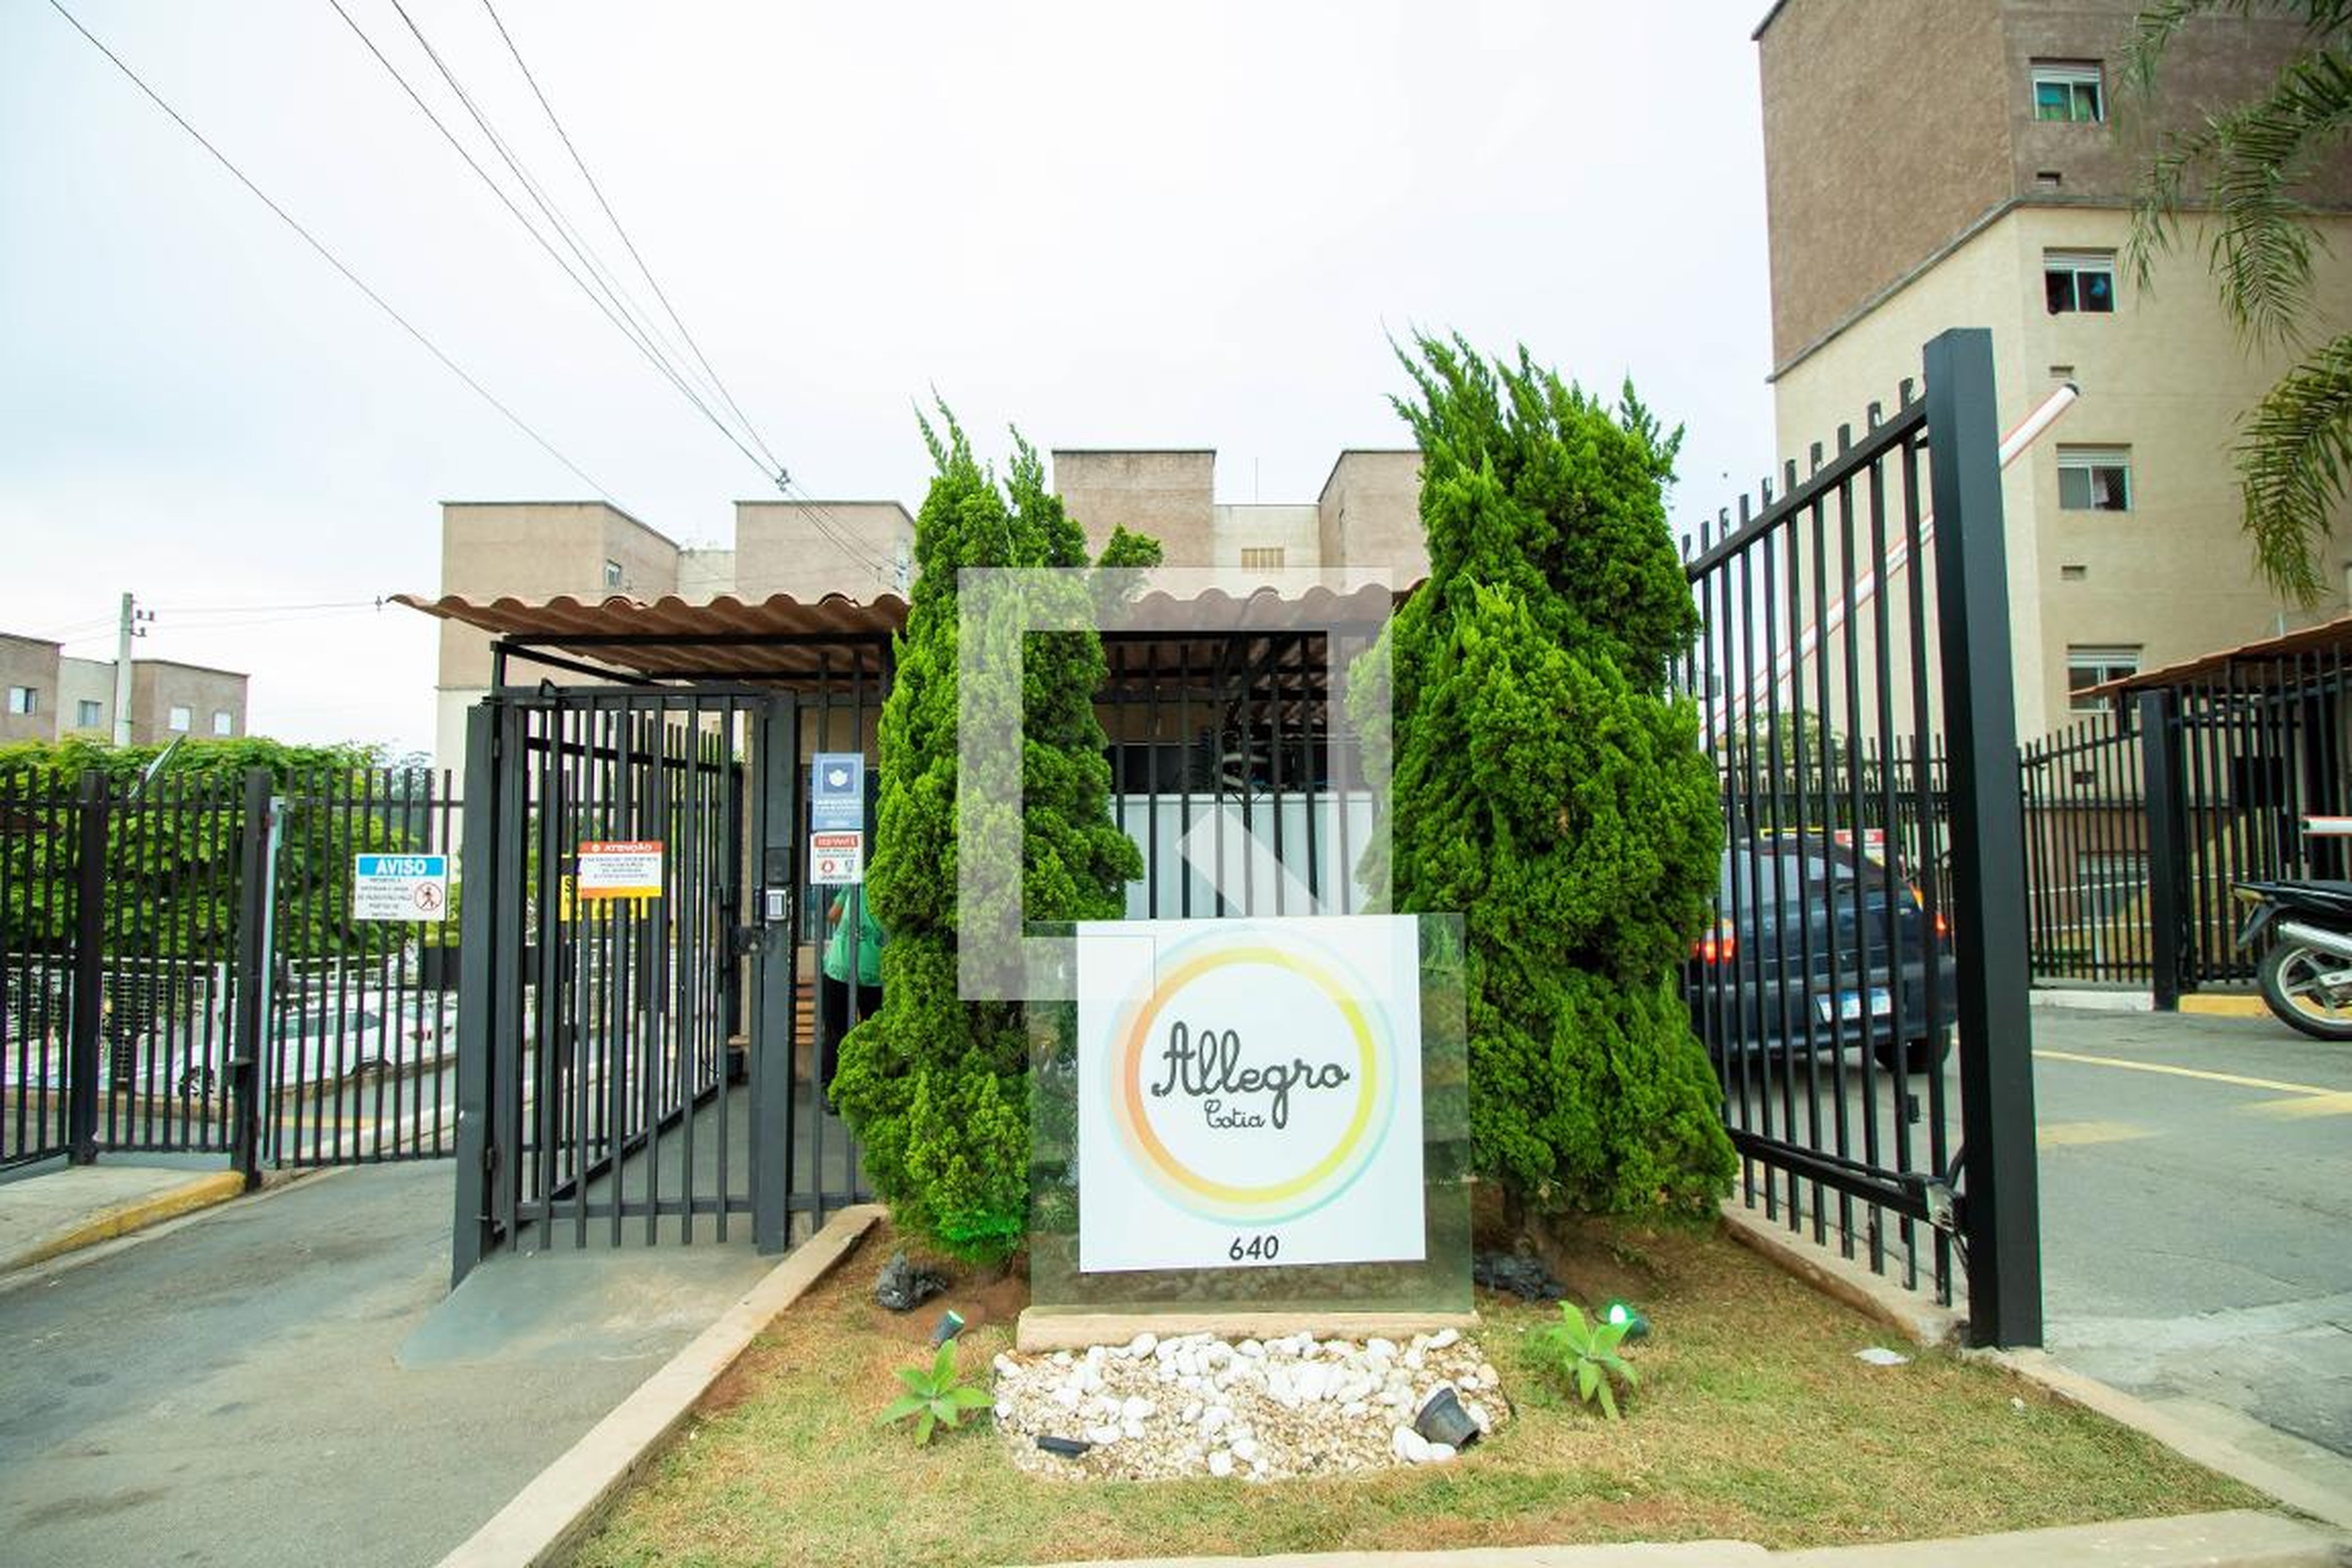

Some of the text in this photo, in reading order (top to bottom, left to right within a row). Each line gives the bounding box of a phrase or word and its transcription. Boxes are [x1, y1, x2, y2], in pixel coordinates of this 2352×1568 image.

[376, 859, 427, 875] AVISO
[1152, 1021, 1350, 1129] Allegro
[1204, 1099, 1266, 1129] Cotia
[1229, 1235, 1280, 1261] 640
